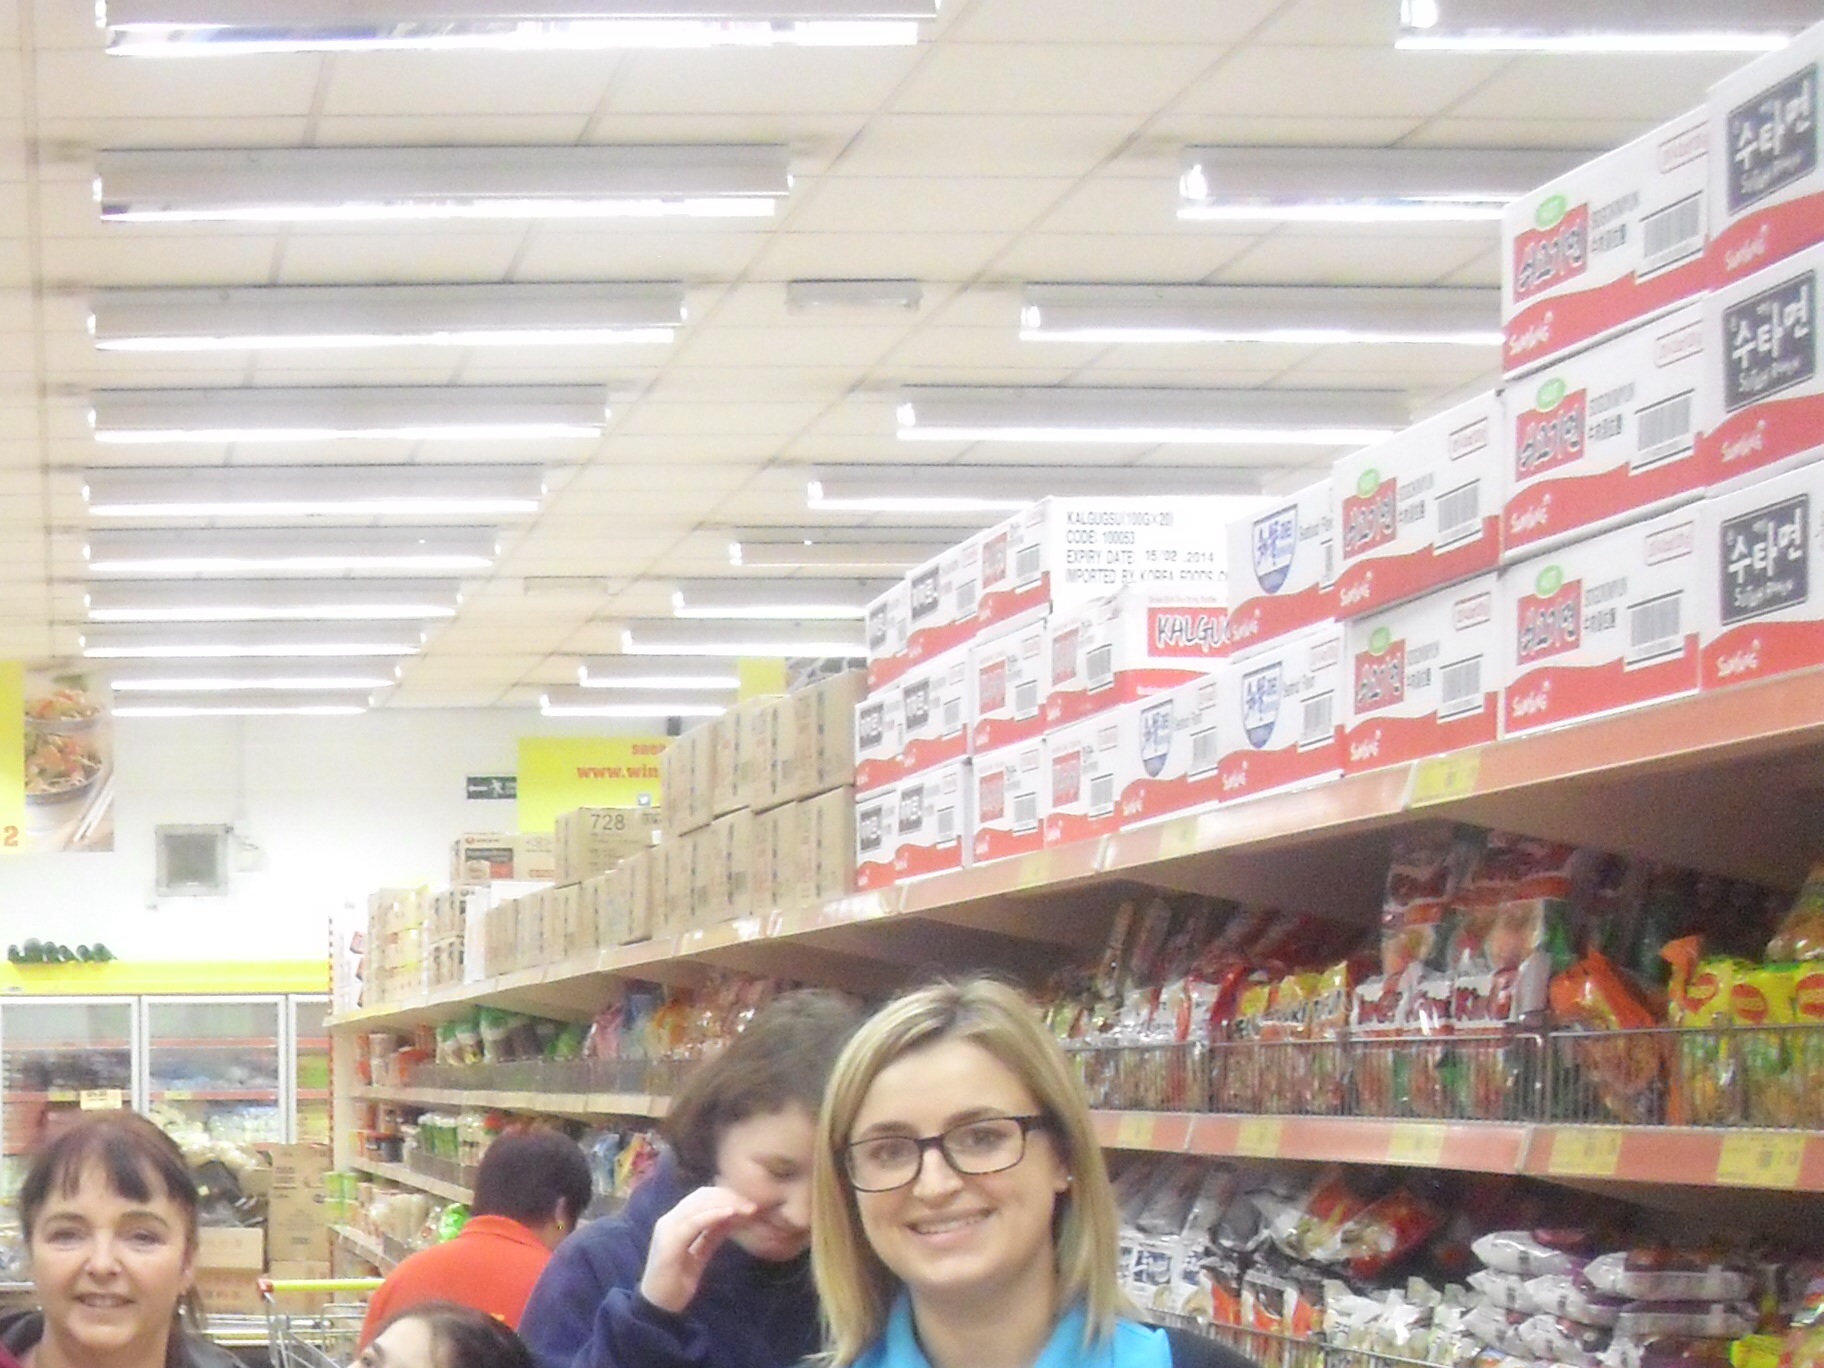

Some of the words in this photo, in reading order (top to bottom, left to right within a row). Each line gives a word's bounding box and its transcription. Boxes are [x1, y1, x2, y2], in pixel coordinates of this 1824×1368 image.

[1735, 79, 1812, 171] 수타면
[1732, 284, 1810, 370] 수타면
[1727, 507, 1804, 585] 수타면
[589, 813, 626, 832] 728
